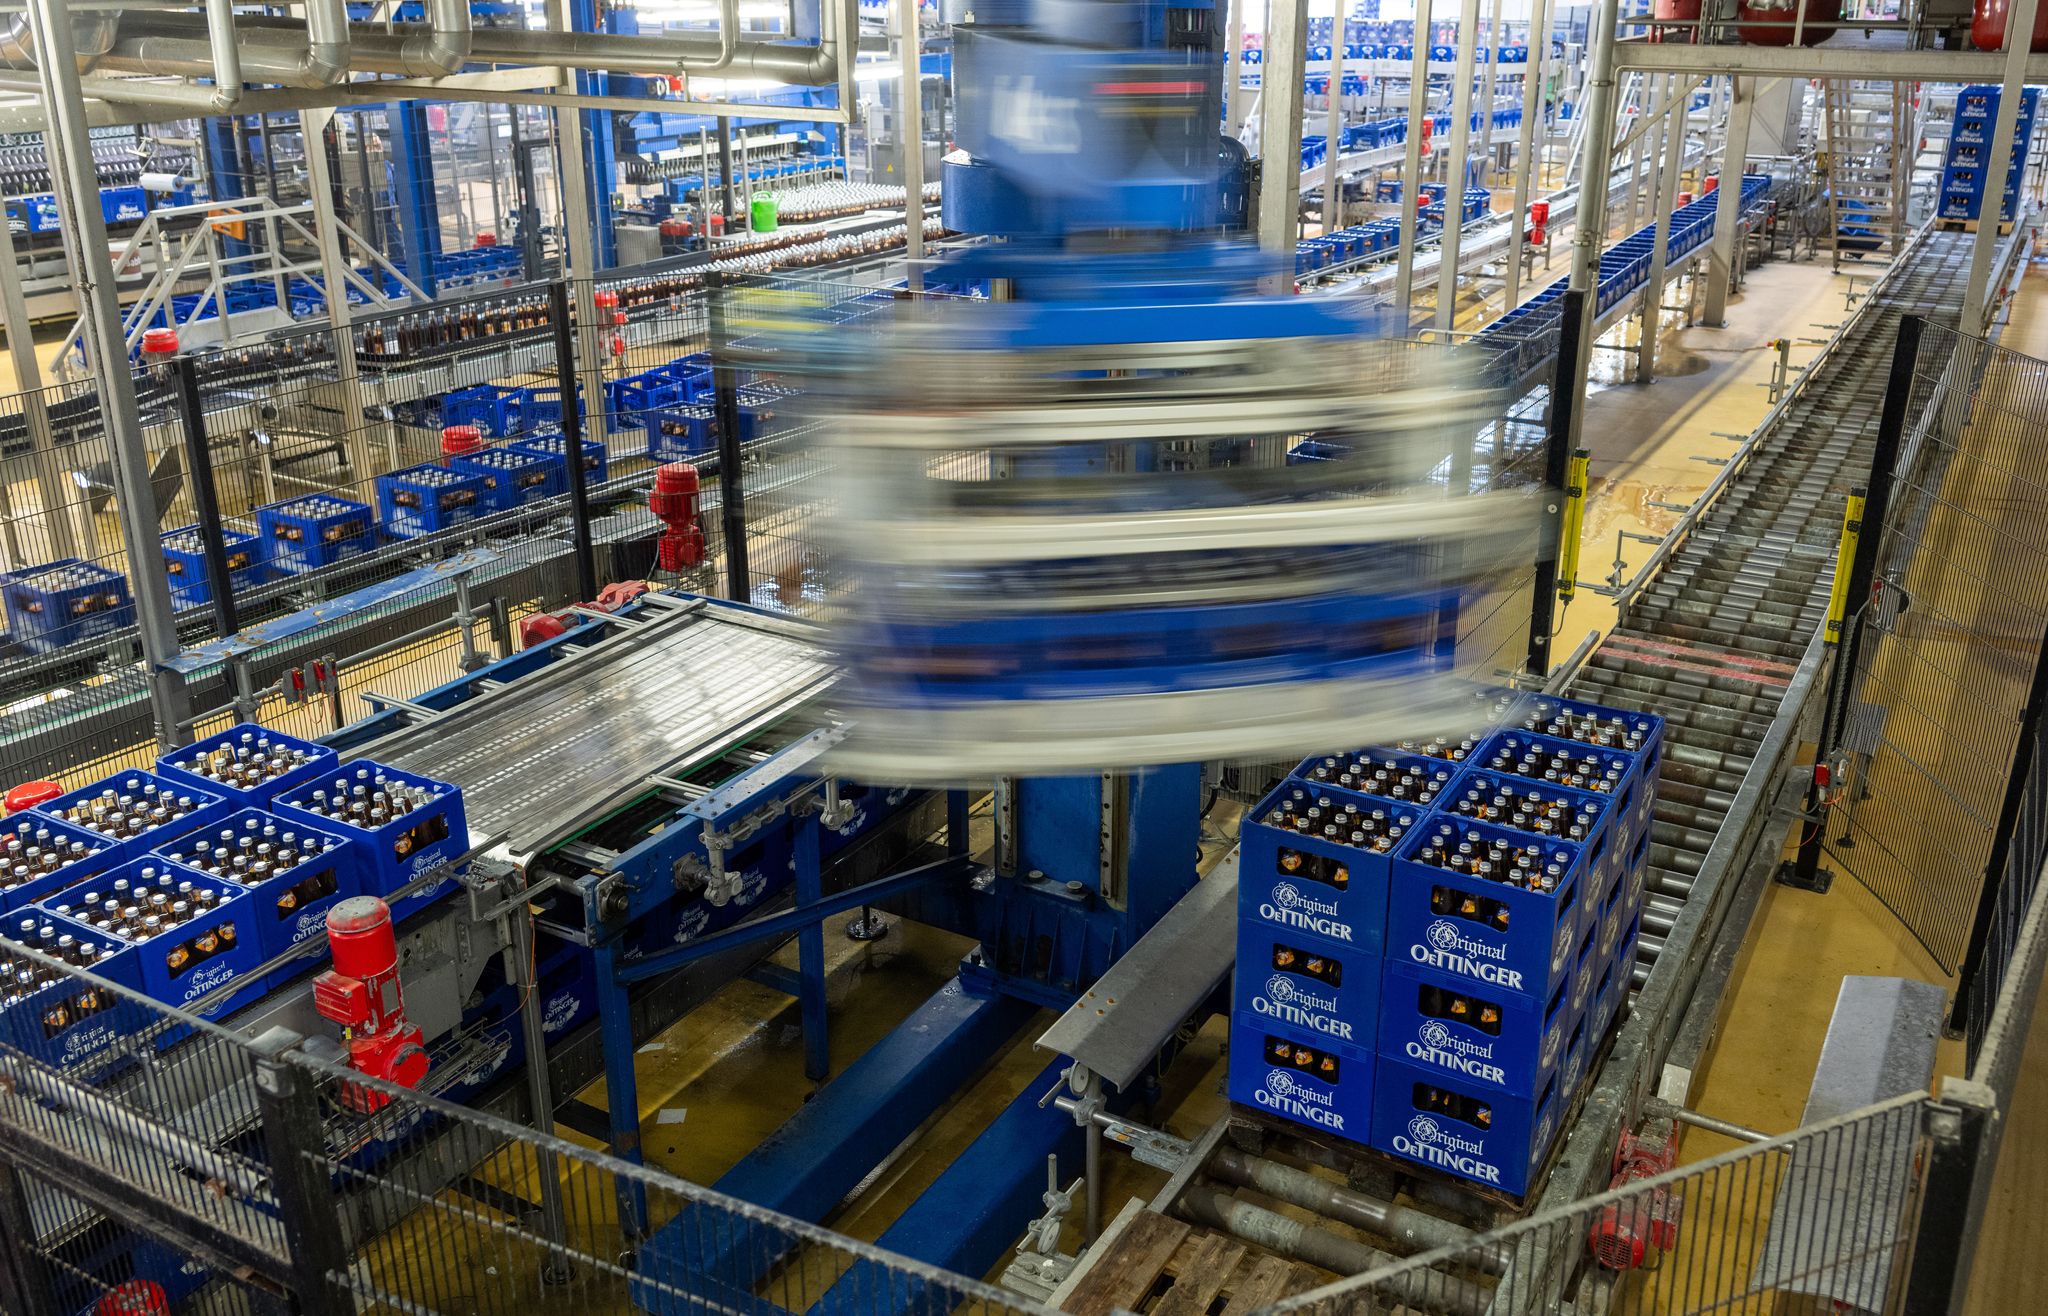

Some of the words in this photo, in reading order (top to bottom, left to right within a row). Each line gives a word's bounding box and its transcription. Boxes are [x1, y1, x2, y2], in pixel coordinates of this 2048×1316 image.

[1271, 882, 1338, 916] Original
[1426, 919, 1507, 961] Original
[1265, 974, 1337, 1014] Original
[1418, 1020, 1493, 1060] Original
[1265, 1068, 1333, 1108] Original
[1407, 1114, 1484, 1156] Original
